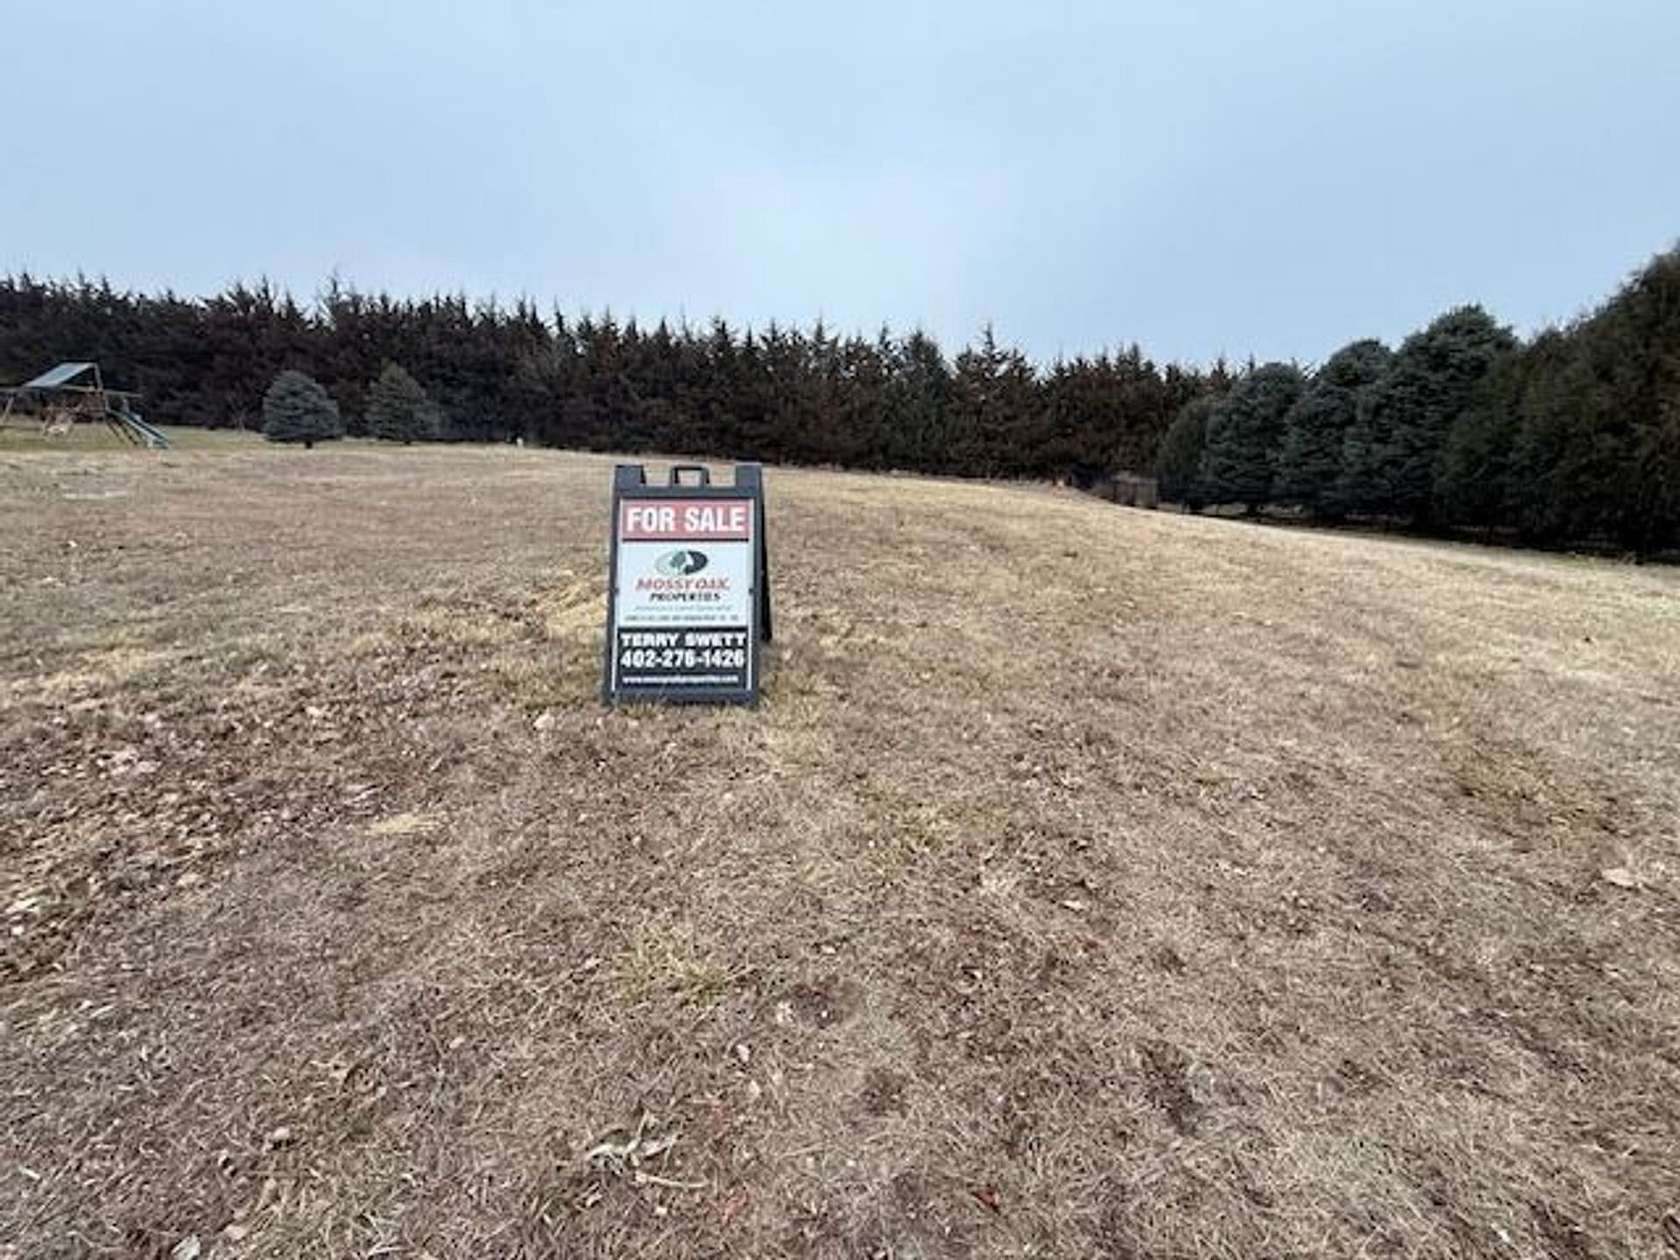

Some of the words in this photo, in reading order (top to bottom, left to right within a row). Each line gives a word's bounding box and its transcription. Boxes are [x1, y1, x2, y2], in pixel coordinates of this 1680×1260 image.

[626, 506, 676, 532] FOR
[684, 506, 746, 532] SALE
[635, 578, 692, 591] MOSSY
[649, 592, 721, 602] PROPERTIES
[620, 632, 680, 647] TERRY
[685, 632, 746, 647] SWETT
